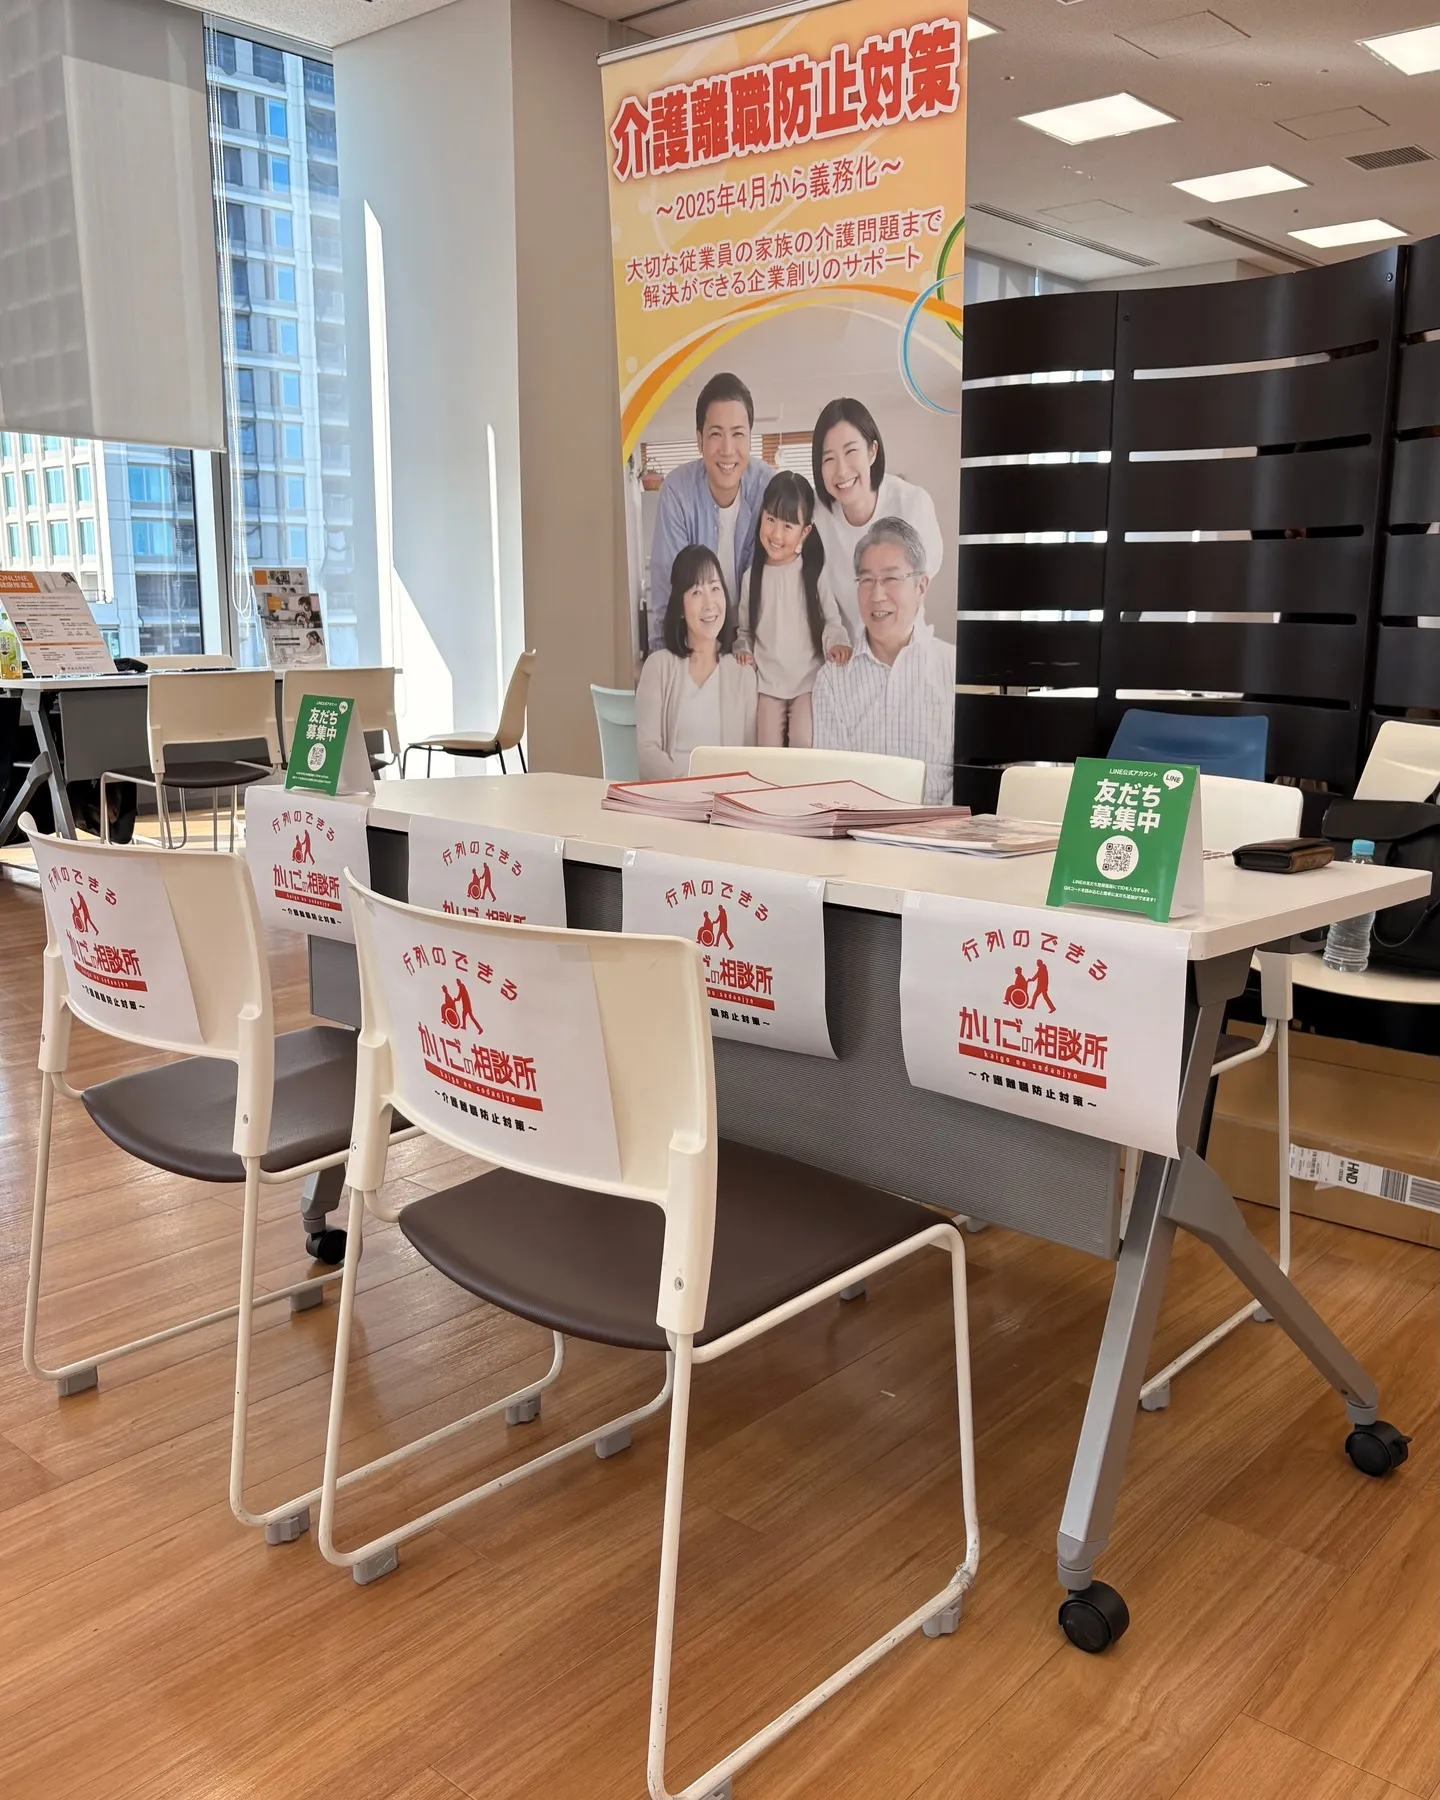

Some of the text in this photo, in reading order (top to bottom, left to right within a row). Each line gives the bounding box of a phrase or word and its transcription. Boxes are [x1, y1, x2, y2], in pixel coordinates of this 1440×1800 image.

[613, 21, 958, 177] 介護離職防止対策
[626, 209, 942, 283] 大切な従業員の家族の介護問題まで
[642, 245, 921, 308] 解決ができる企業創りのサポート
[306, 724, 337, 742] 募集中
[308, 708, 338, 725] 友だち
[1094, 778, 1161, 808] 友だち
[1166, 775, 1181, 783] LINE
[272, 810, 335, 842] 行列のできる
[1090, 804, 1161, 834] 募集中
[442, 841, 522, 876] 行列のできる
[48, 866, 117, 906] 行列のできる
[273, 864, 340, 900] かいごの相談所
[665, 880, 769, 922] 行列のできる
[402, 944, 518, 1001] 行列のできる
[962, 929, 1108, 981] 行列のできる
[959, 1006, 1108, 1070] かいごの相談所
[417, 1021, 536, 1092] かいごの相談所
[984, 1051, 1010, 1064] kaigo
[1032, 1063, 1078, 1079] sodanjyo
[1346, 1162, 1360, 1184] HND
